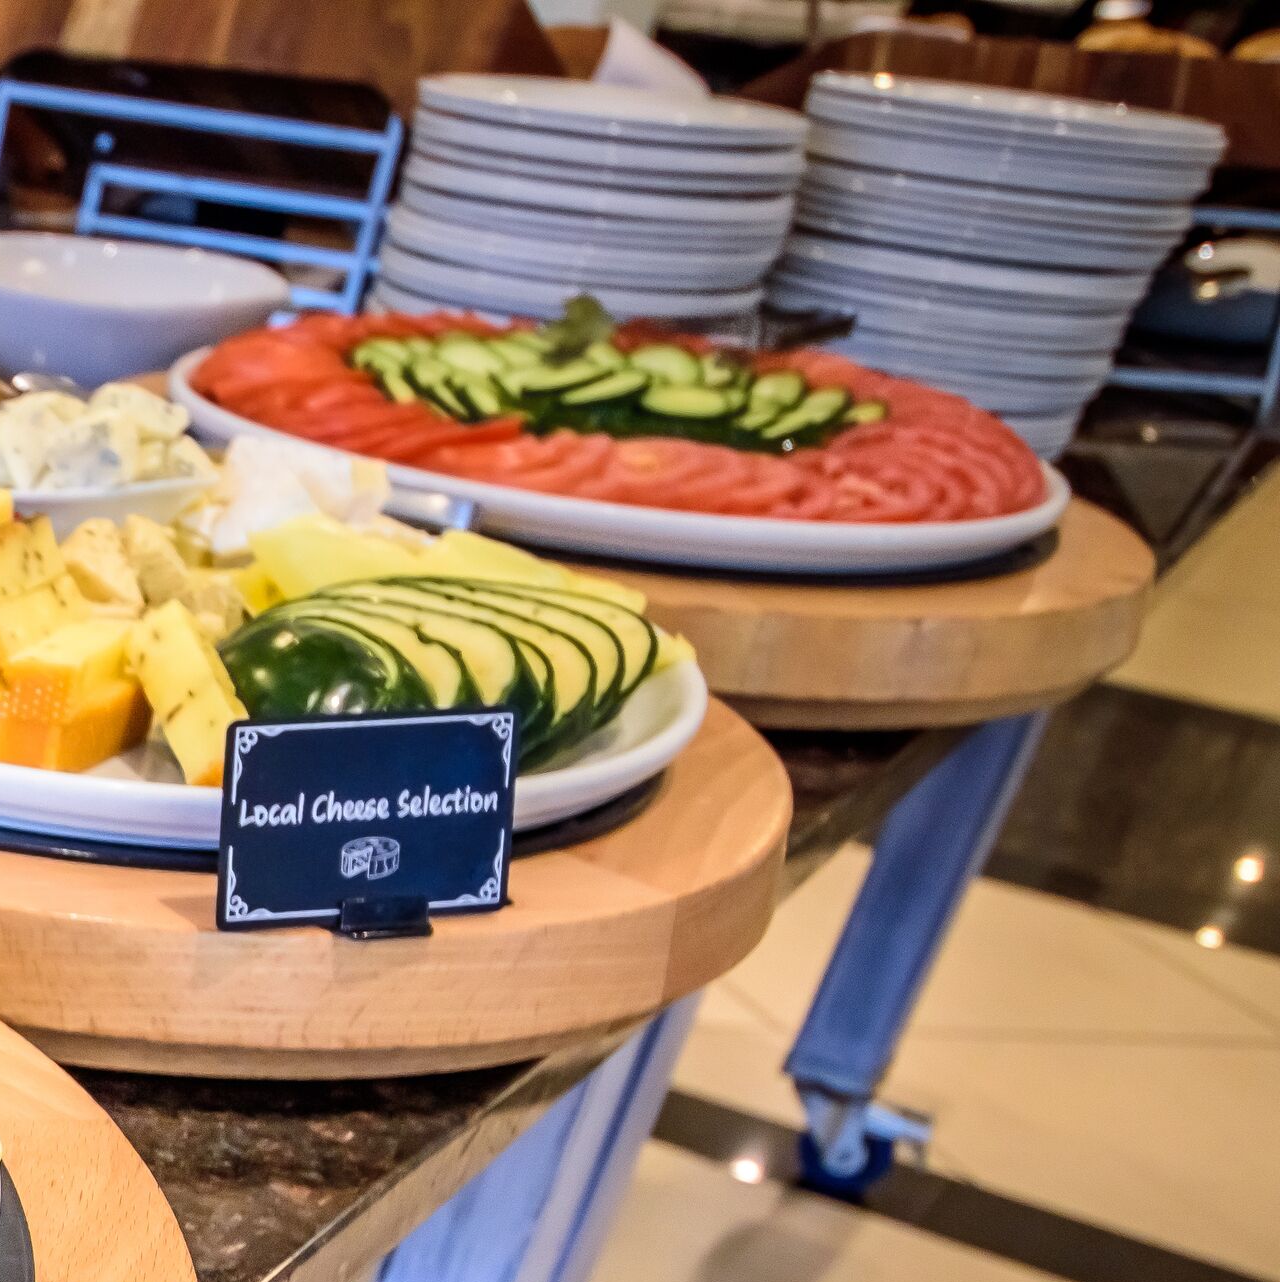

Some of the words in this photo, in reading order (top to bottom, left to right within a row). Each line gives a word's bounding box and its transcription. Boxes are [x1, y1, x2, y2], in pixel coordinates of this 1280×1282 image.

[239, 792, 305, 828] Local
[311, 790, 390, 824] Cheese
[397, 785, 498, 818] Selection
